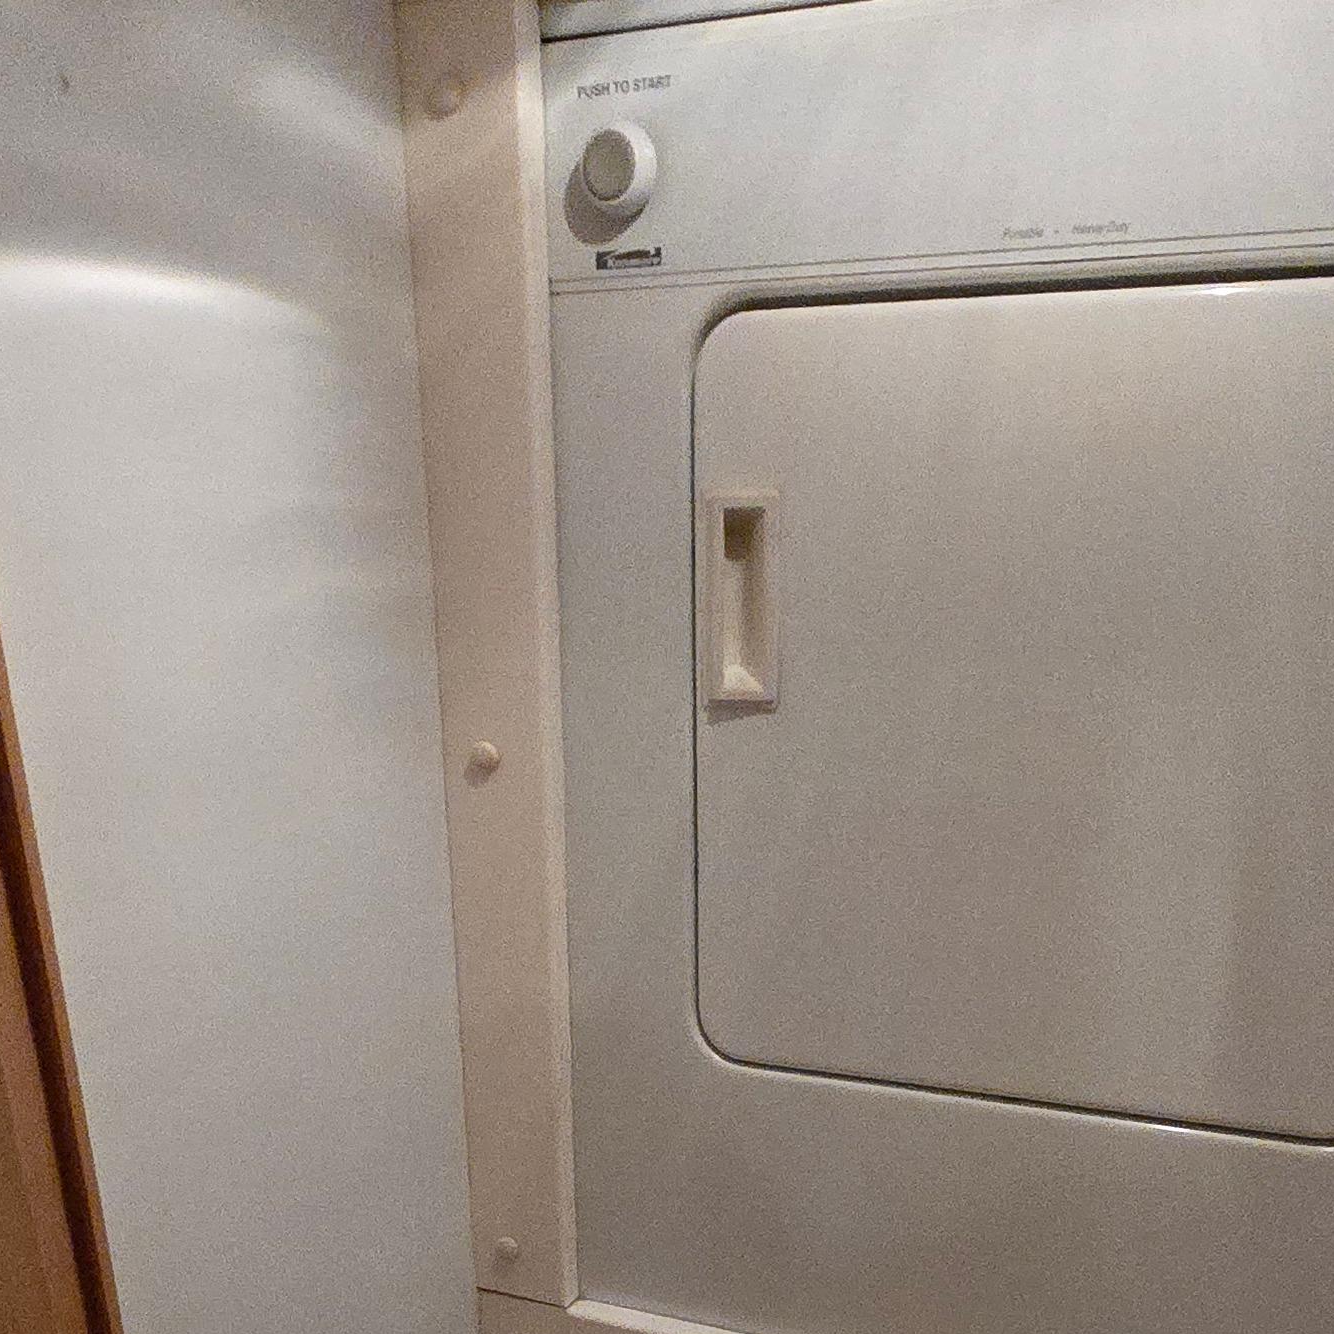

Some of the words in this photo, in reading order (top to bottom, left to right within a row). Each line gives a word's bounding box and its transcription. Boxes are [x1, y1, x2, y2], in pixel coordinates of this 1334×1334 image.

[576, 82, 610, 100] PUSH
[612, 79, 630, 94] TO
[632, 74, 672, 92] START
